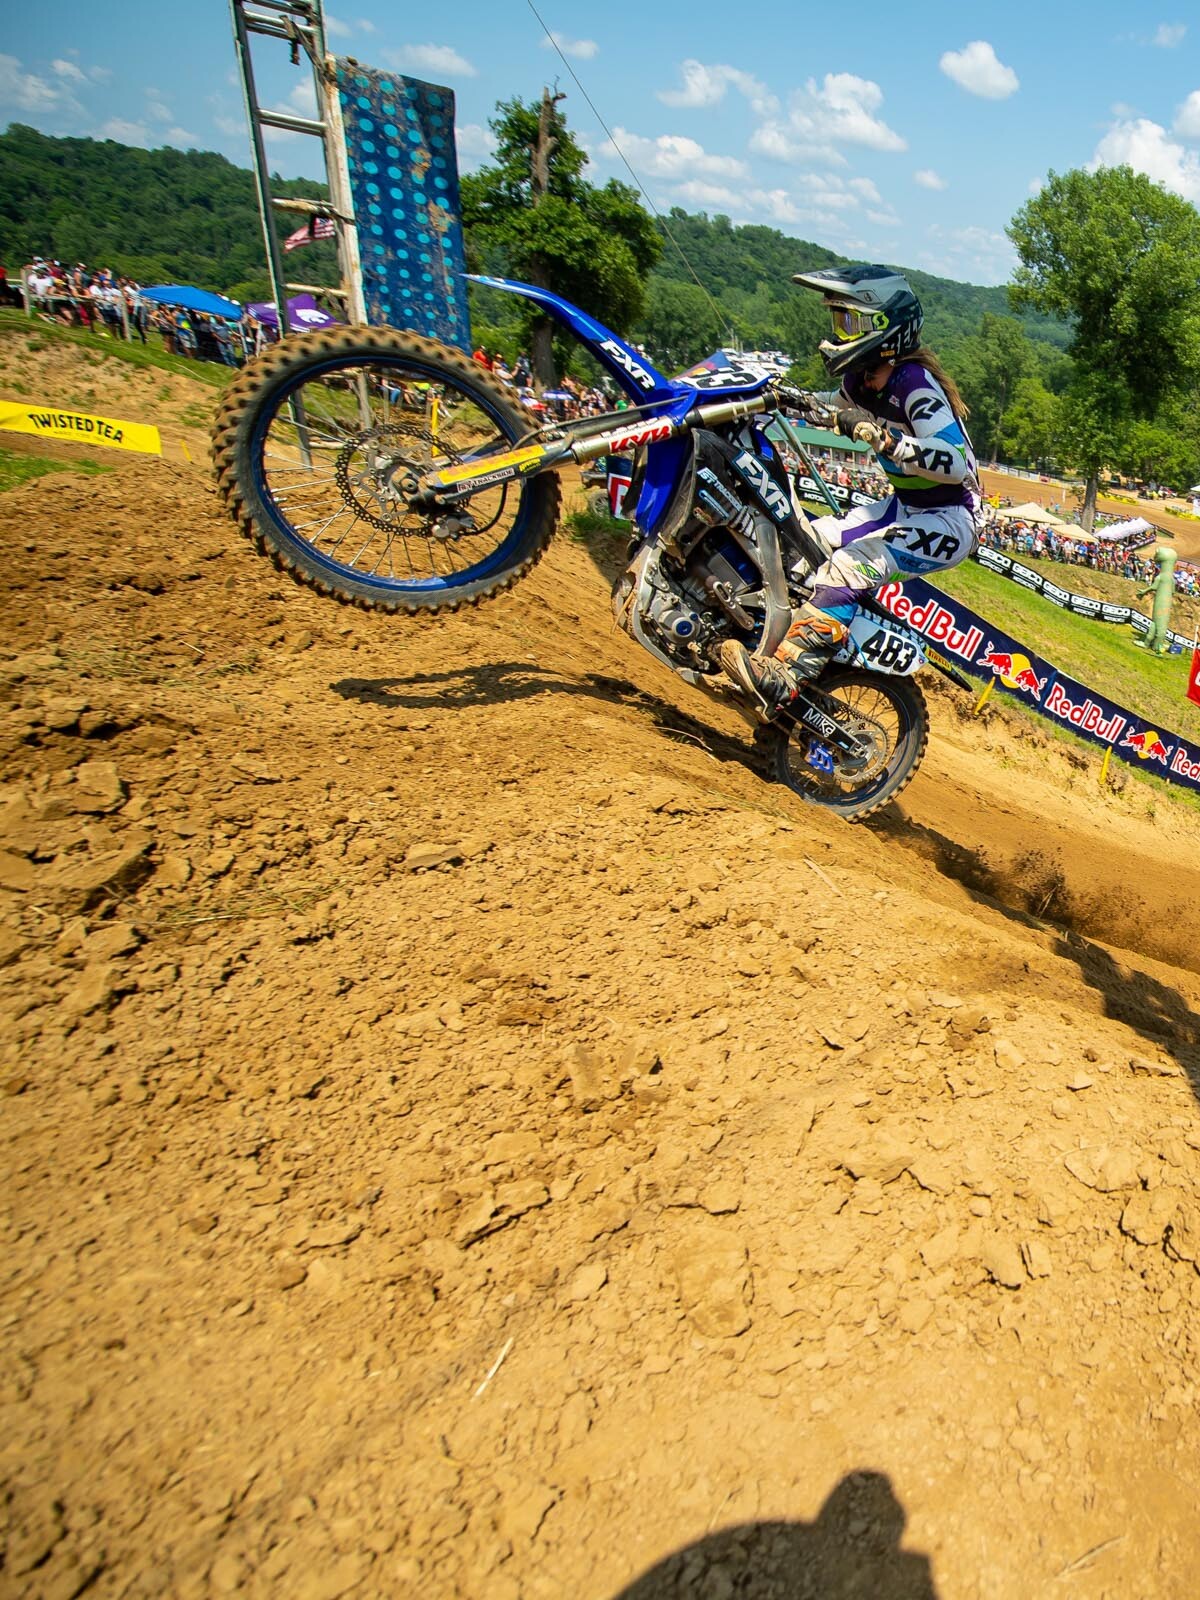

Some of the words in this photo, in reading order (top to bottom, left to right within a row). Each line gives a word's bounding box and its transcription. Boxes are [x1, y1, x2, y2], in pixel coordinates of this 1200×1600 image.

[600, 338, 656, 389] FXR
[28, 413, 94, 432] TWISTED
[96, 420, 124, 443] TEA
[736, 451, 791, 519] FXR
[882, 527, 960, 560] FXR
[977, 545, 1011, 568] GEICO
[1012, 563, 1042, 584] GEICO
[1043, 581, 1070, 602] GEICO
[1071, 595, 1101, 611] GEICO
[875, 581, 939, 632] Red
[925, 605, 984, 661] Bull
[1102, 604, 1130, 617] GEICO
[860, 630, 918, 673] 483
[927, 649, 951, 668] PIRELLI
[803, 708, 836, 737] Mika
[1044, 682, 1092, 727] Red
[1082, 703, 1127, 743] Bull
